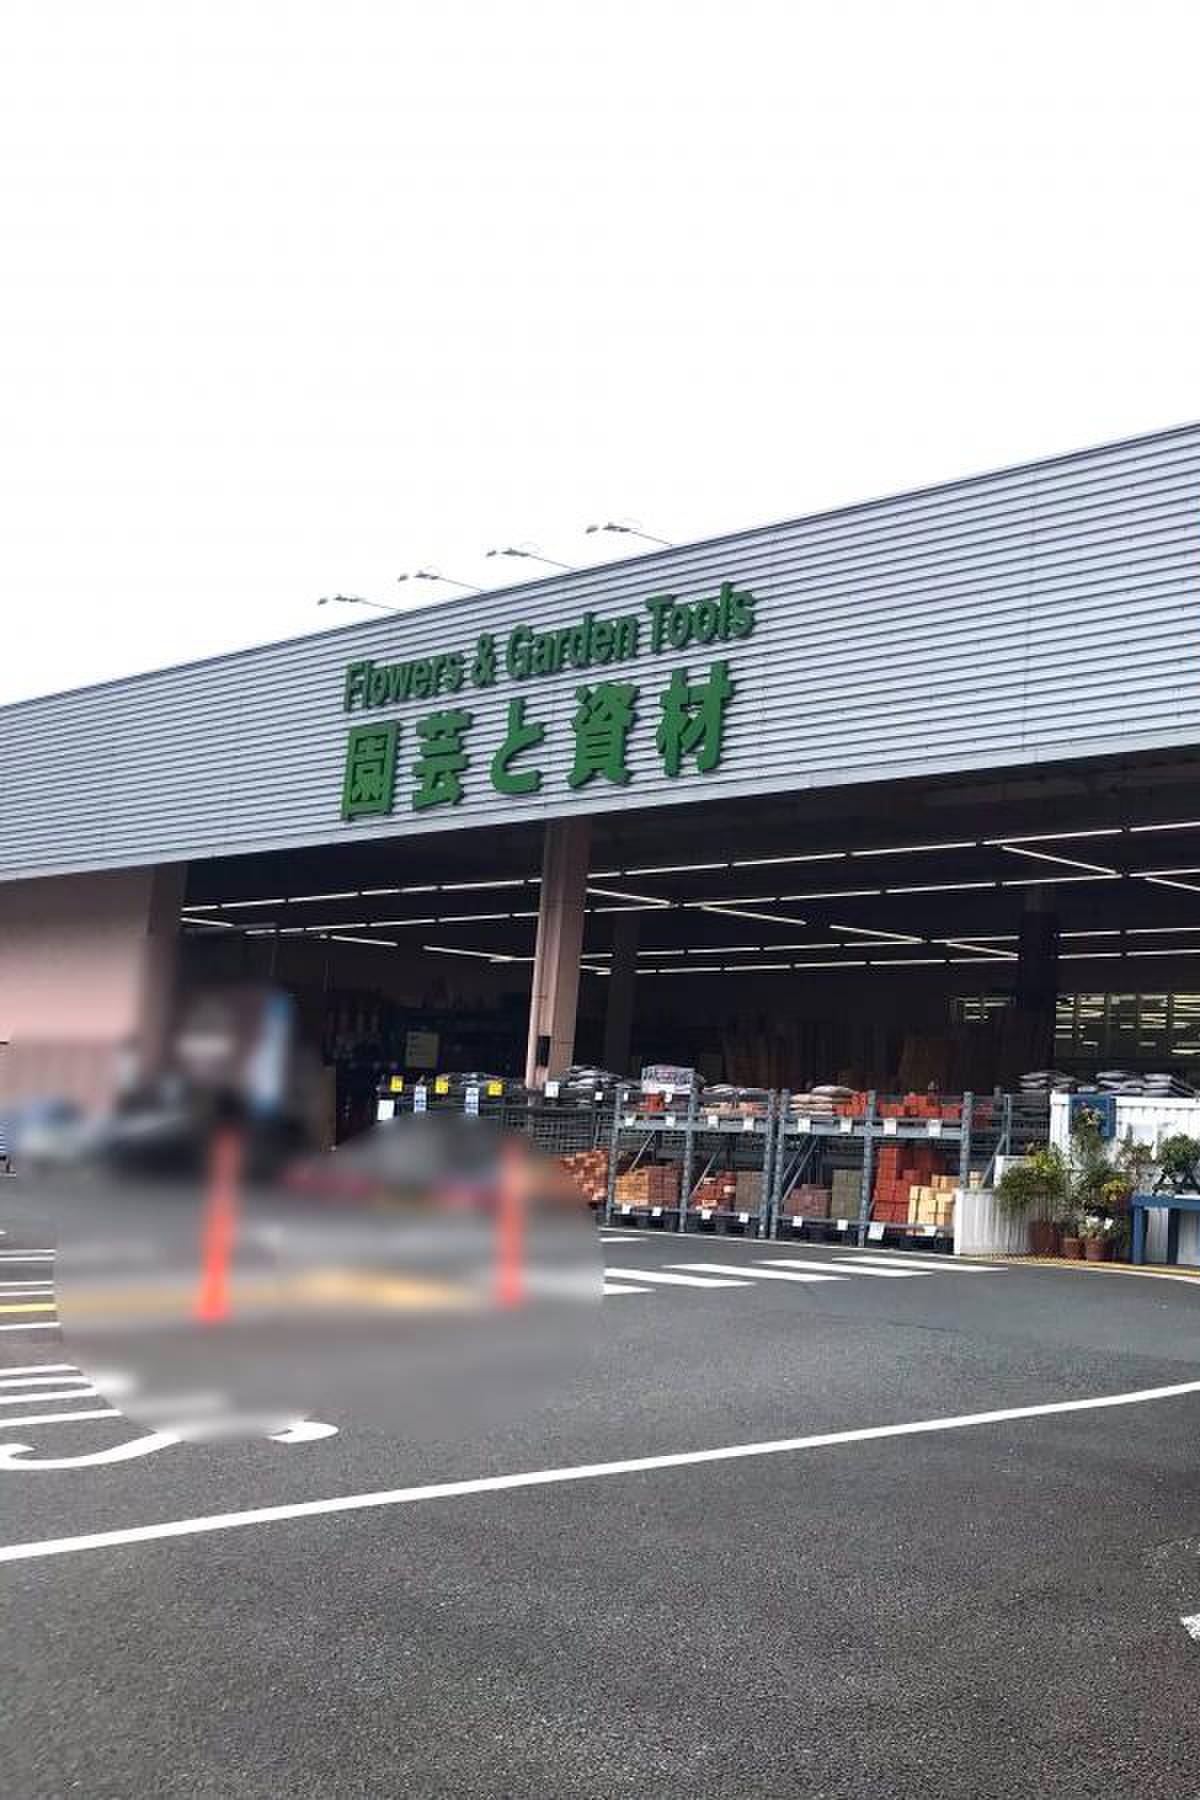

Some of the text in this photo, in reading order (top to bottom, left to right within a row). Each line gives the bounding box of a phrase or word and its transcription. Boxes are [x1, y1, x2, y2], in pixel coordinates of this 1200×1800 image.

[343, 580, 757, 712] Flowers & Garden Tools
[341, 660, 735, 822] 園芸と資材
